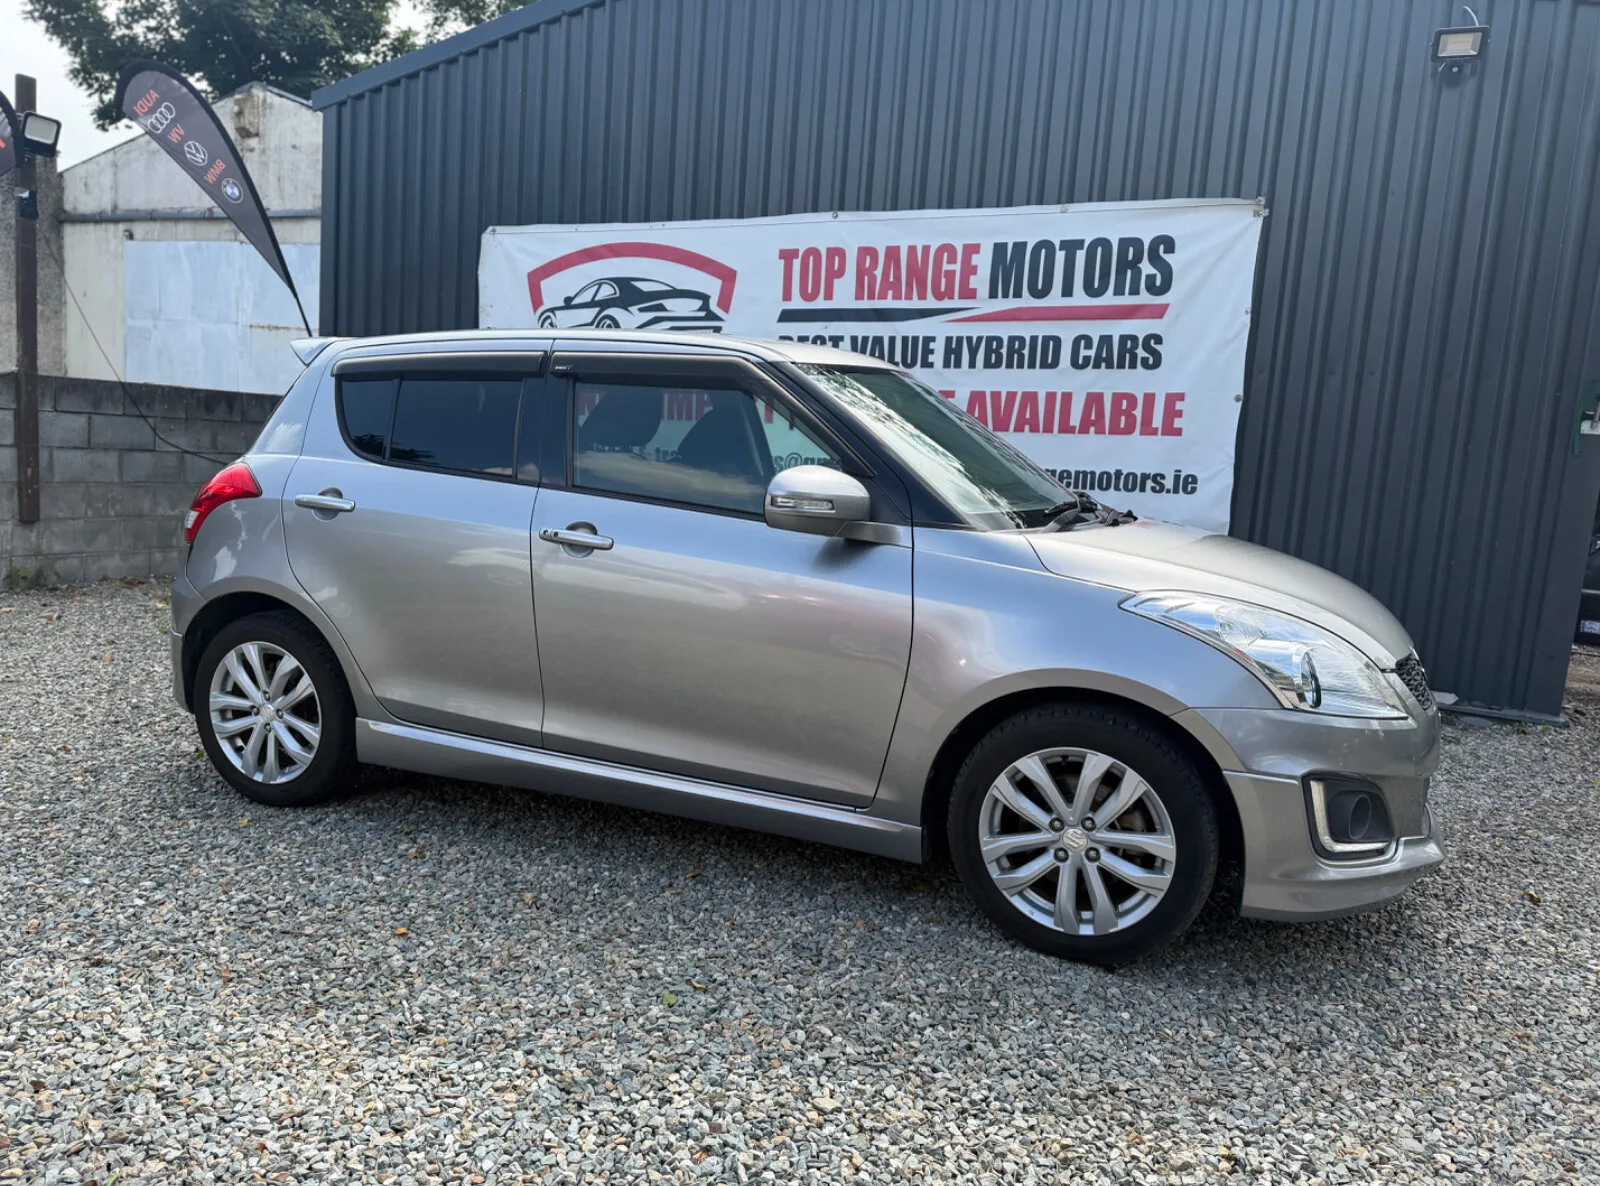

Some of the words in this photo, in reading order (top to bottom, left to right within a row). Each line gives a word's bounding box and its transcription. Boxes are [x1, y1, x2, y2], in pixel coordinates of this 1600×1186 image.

[778, 246, 847, 302] TOP
[854, 242, 981, 302] RANGE
[988, 234, 1176, 300] MOTORS
[850, 335, 936, 369] VALUE
[942, 334, 1062, 370] HYBRID
[1069, 333, 1164, 370] CARS
[965, 390, 1186, 437] AVAILABLE
